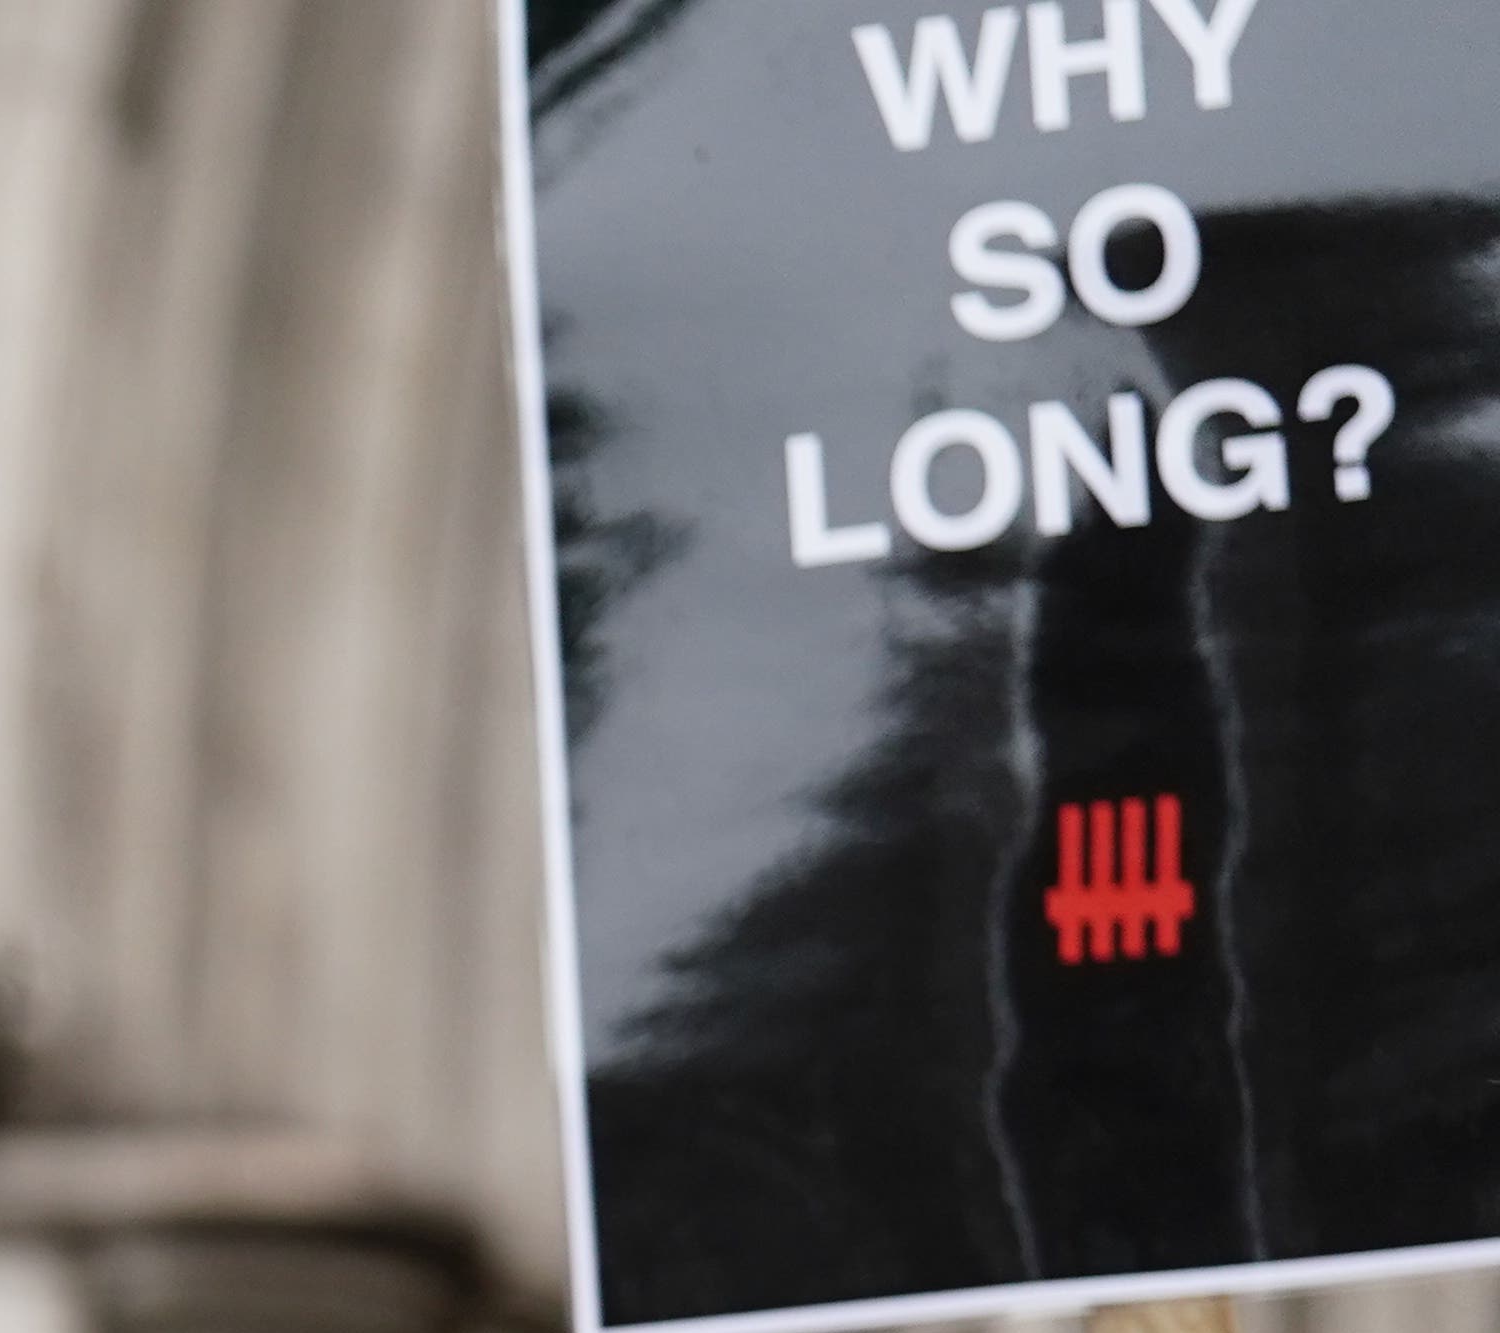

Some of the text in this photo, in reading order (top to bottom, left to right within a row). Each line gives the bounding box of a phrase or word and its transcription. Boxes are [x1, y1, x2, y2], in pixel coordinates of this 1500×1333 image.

[852, 0, 1259, 152] WHY
[948, 183, 1202, 341] SO
[785, 364, 1395, 567] LONG?
